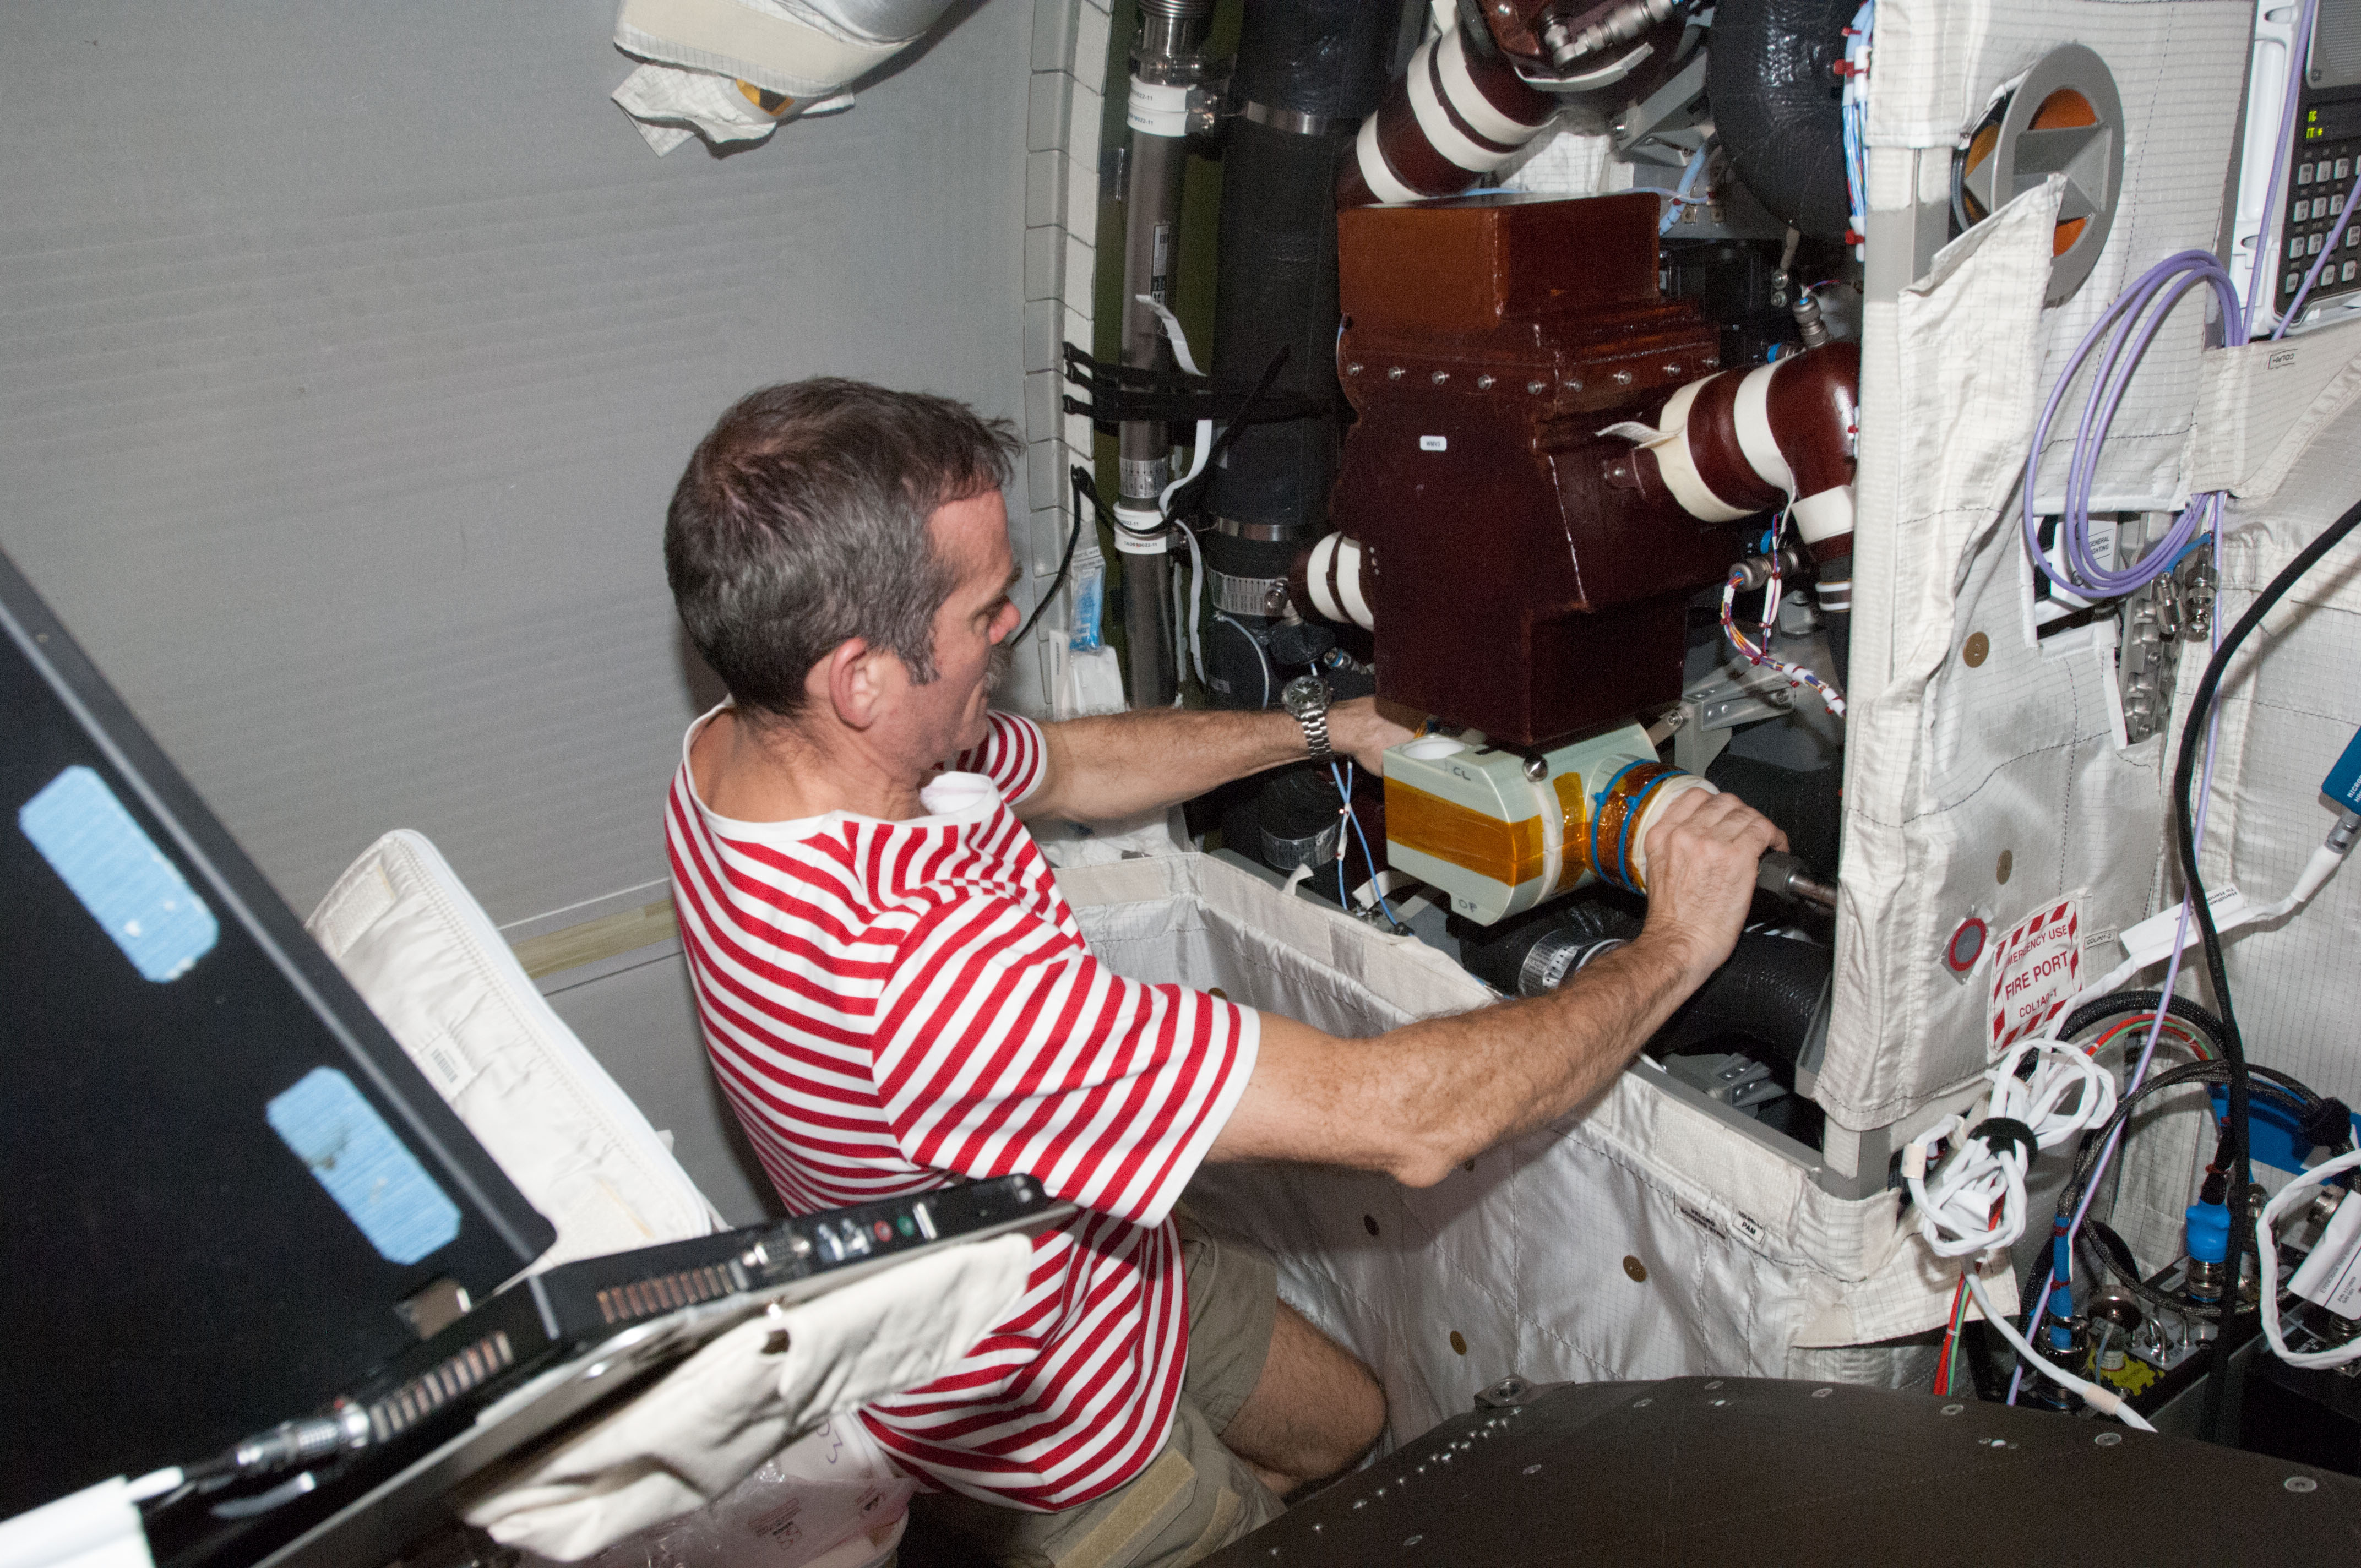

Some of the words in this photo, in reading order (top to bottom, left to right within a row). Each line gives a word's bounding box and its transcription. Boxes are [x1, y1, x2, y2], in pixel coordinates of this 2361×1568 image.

[2048, 924, 2068, 940] USE
[2005, 971, 2031, 1001] FIRE
[2033, 950, 2069, 982] PORT
[1742, 1221, 1756, 1235] PAM
